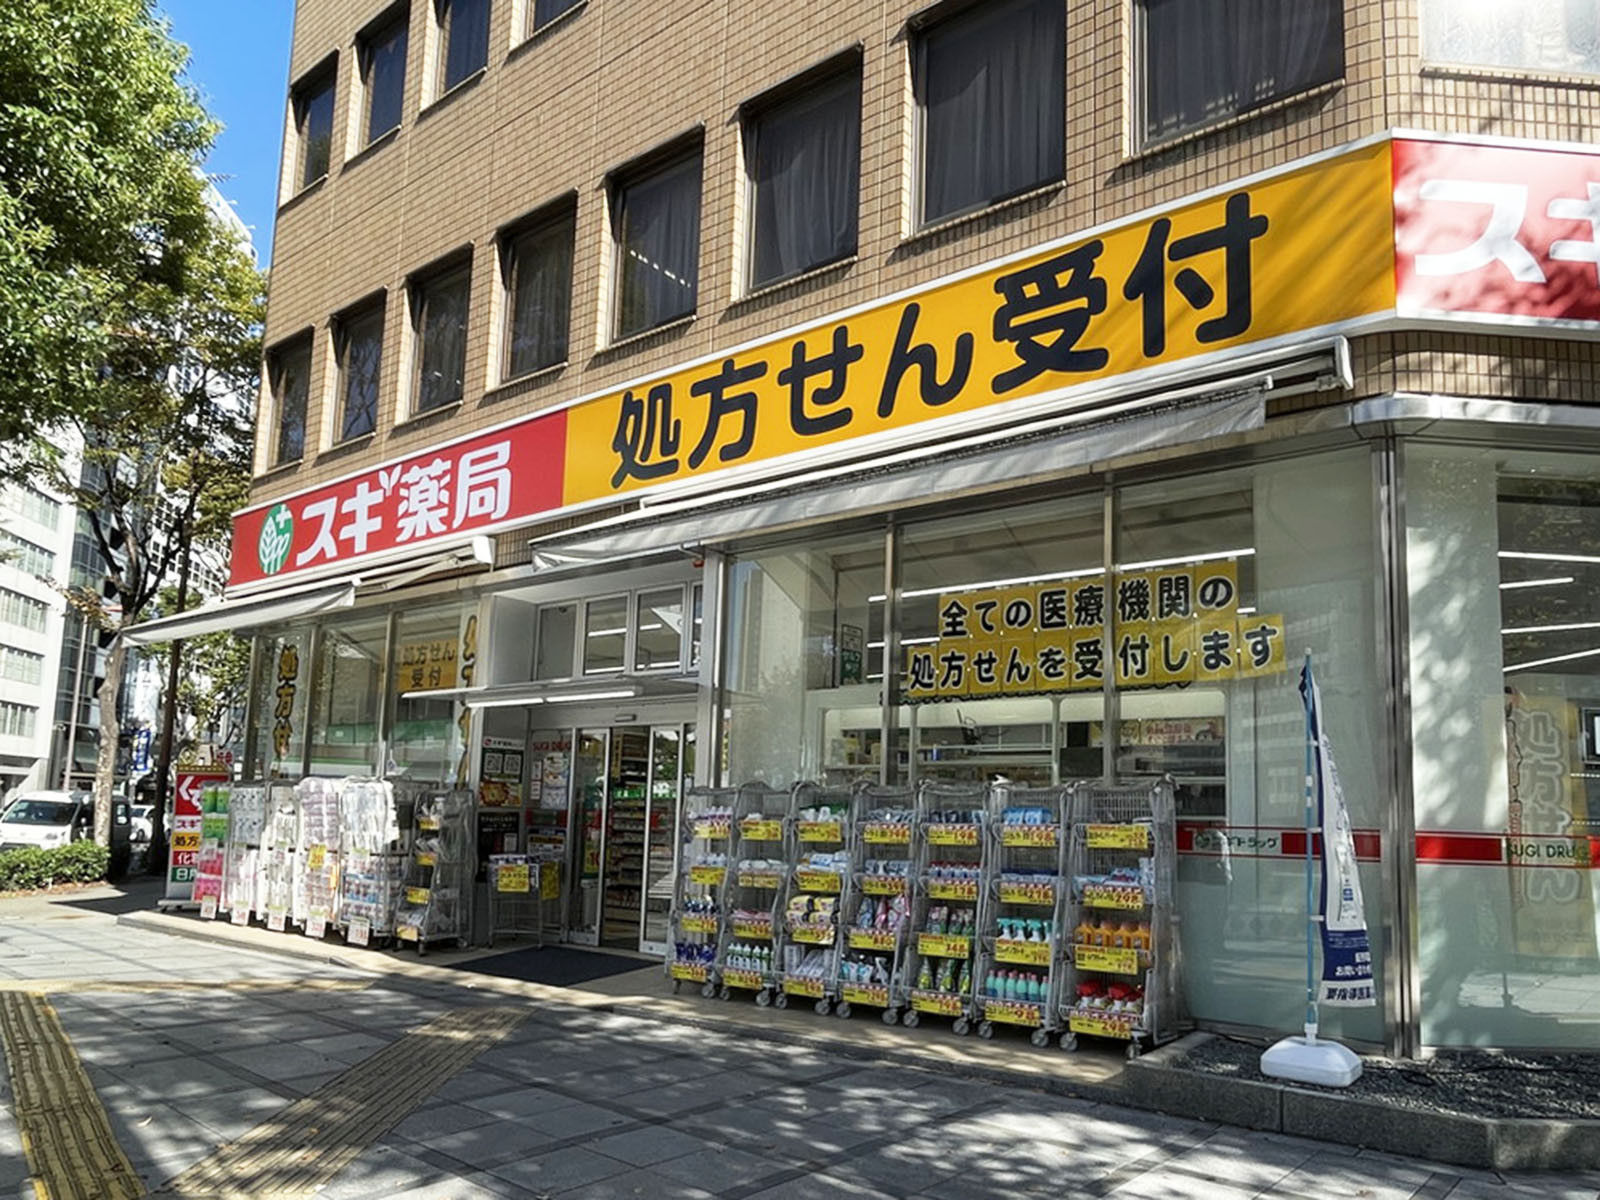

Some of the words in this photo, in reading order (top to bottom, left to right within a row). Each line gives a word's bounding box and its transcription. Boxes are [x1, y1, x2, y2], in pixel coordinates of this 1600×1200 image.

[610, 191, 1268, 490] 処方せん受付
[296, 440, 512, 566] スギ薬局
[940, 574, 1234, 639] 全ての医療機関の
[411, 667, 443, 688] 受付
[909, 623, 1280, 691] 処方せんを受付します
